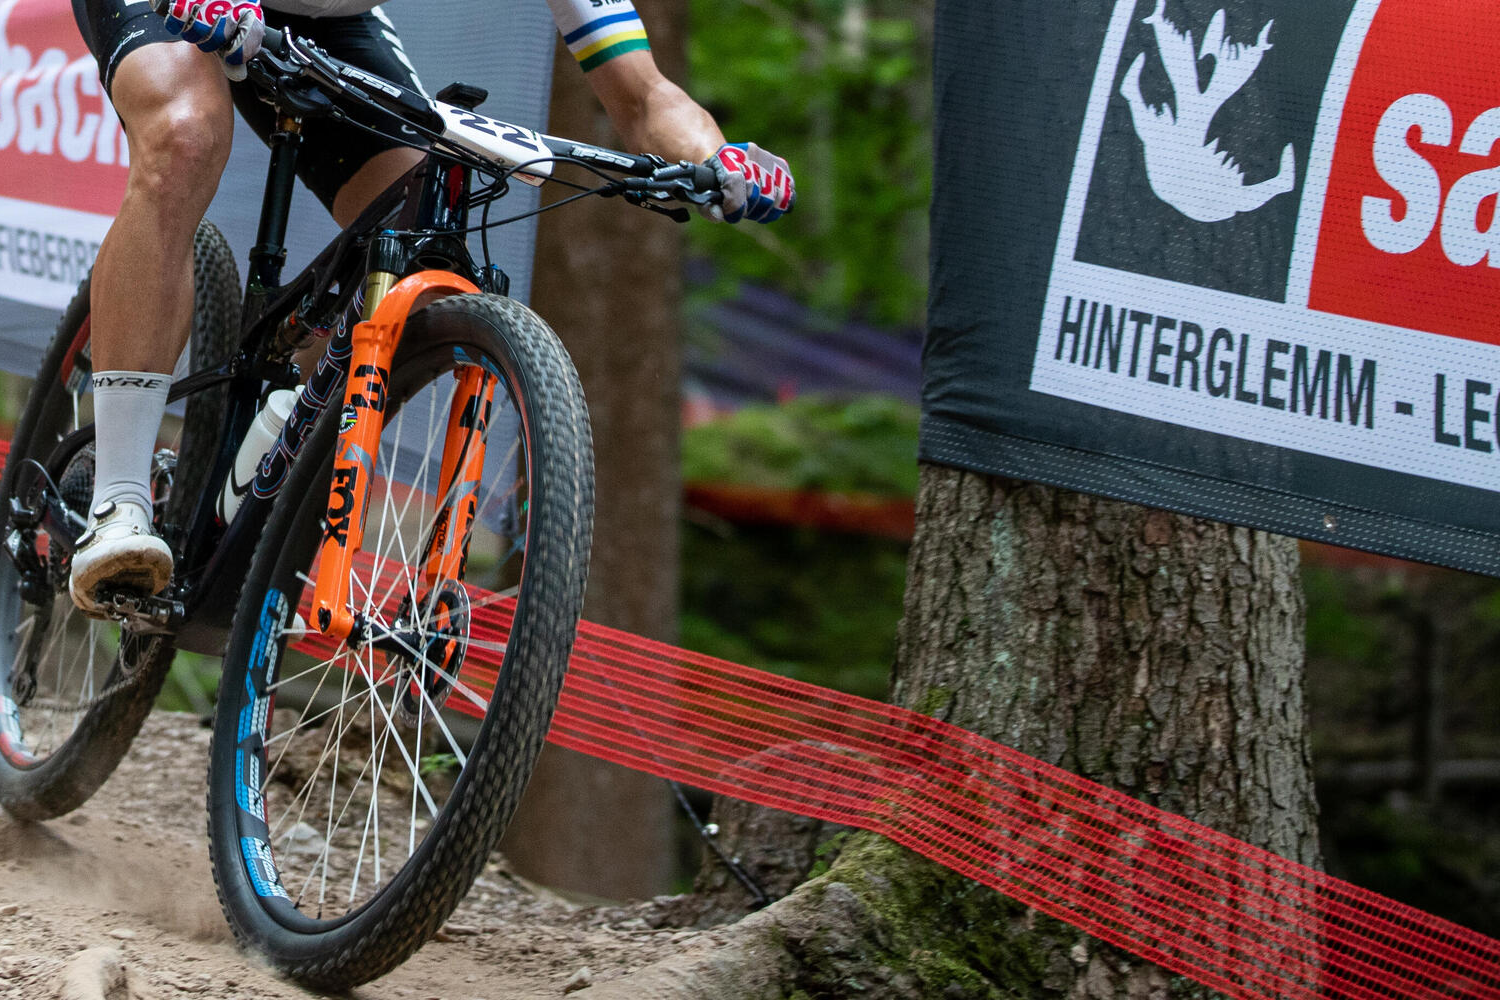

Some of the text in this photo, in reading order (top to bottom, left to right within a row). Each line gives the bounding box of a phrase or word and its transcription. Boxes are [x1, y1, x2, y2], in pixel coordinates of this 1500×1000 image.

[450, 109, 540, 153] 22
[1053, 295, 1377, 430] HINTERGLEMM
[1433, 372, 1500, 454] LE
[322, 466, 358, 548] FOX
